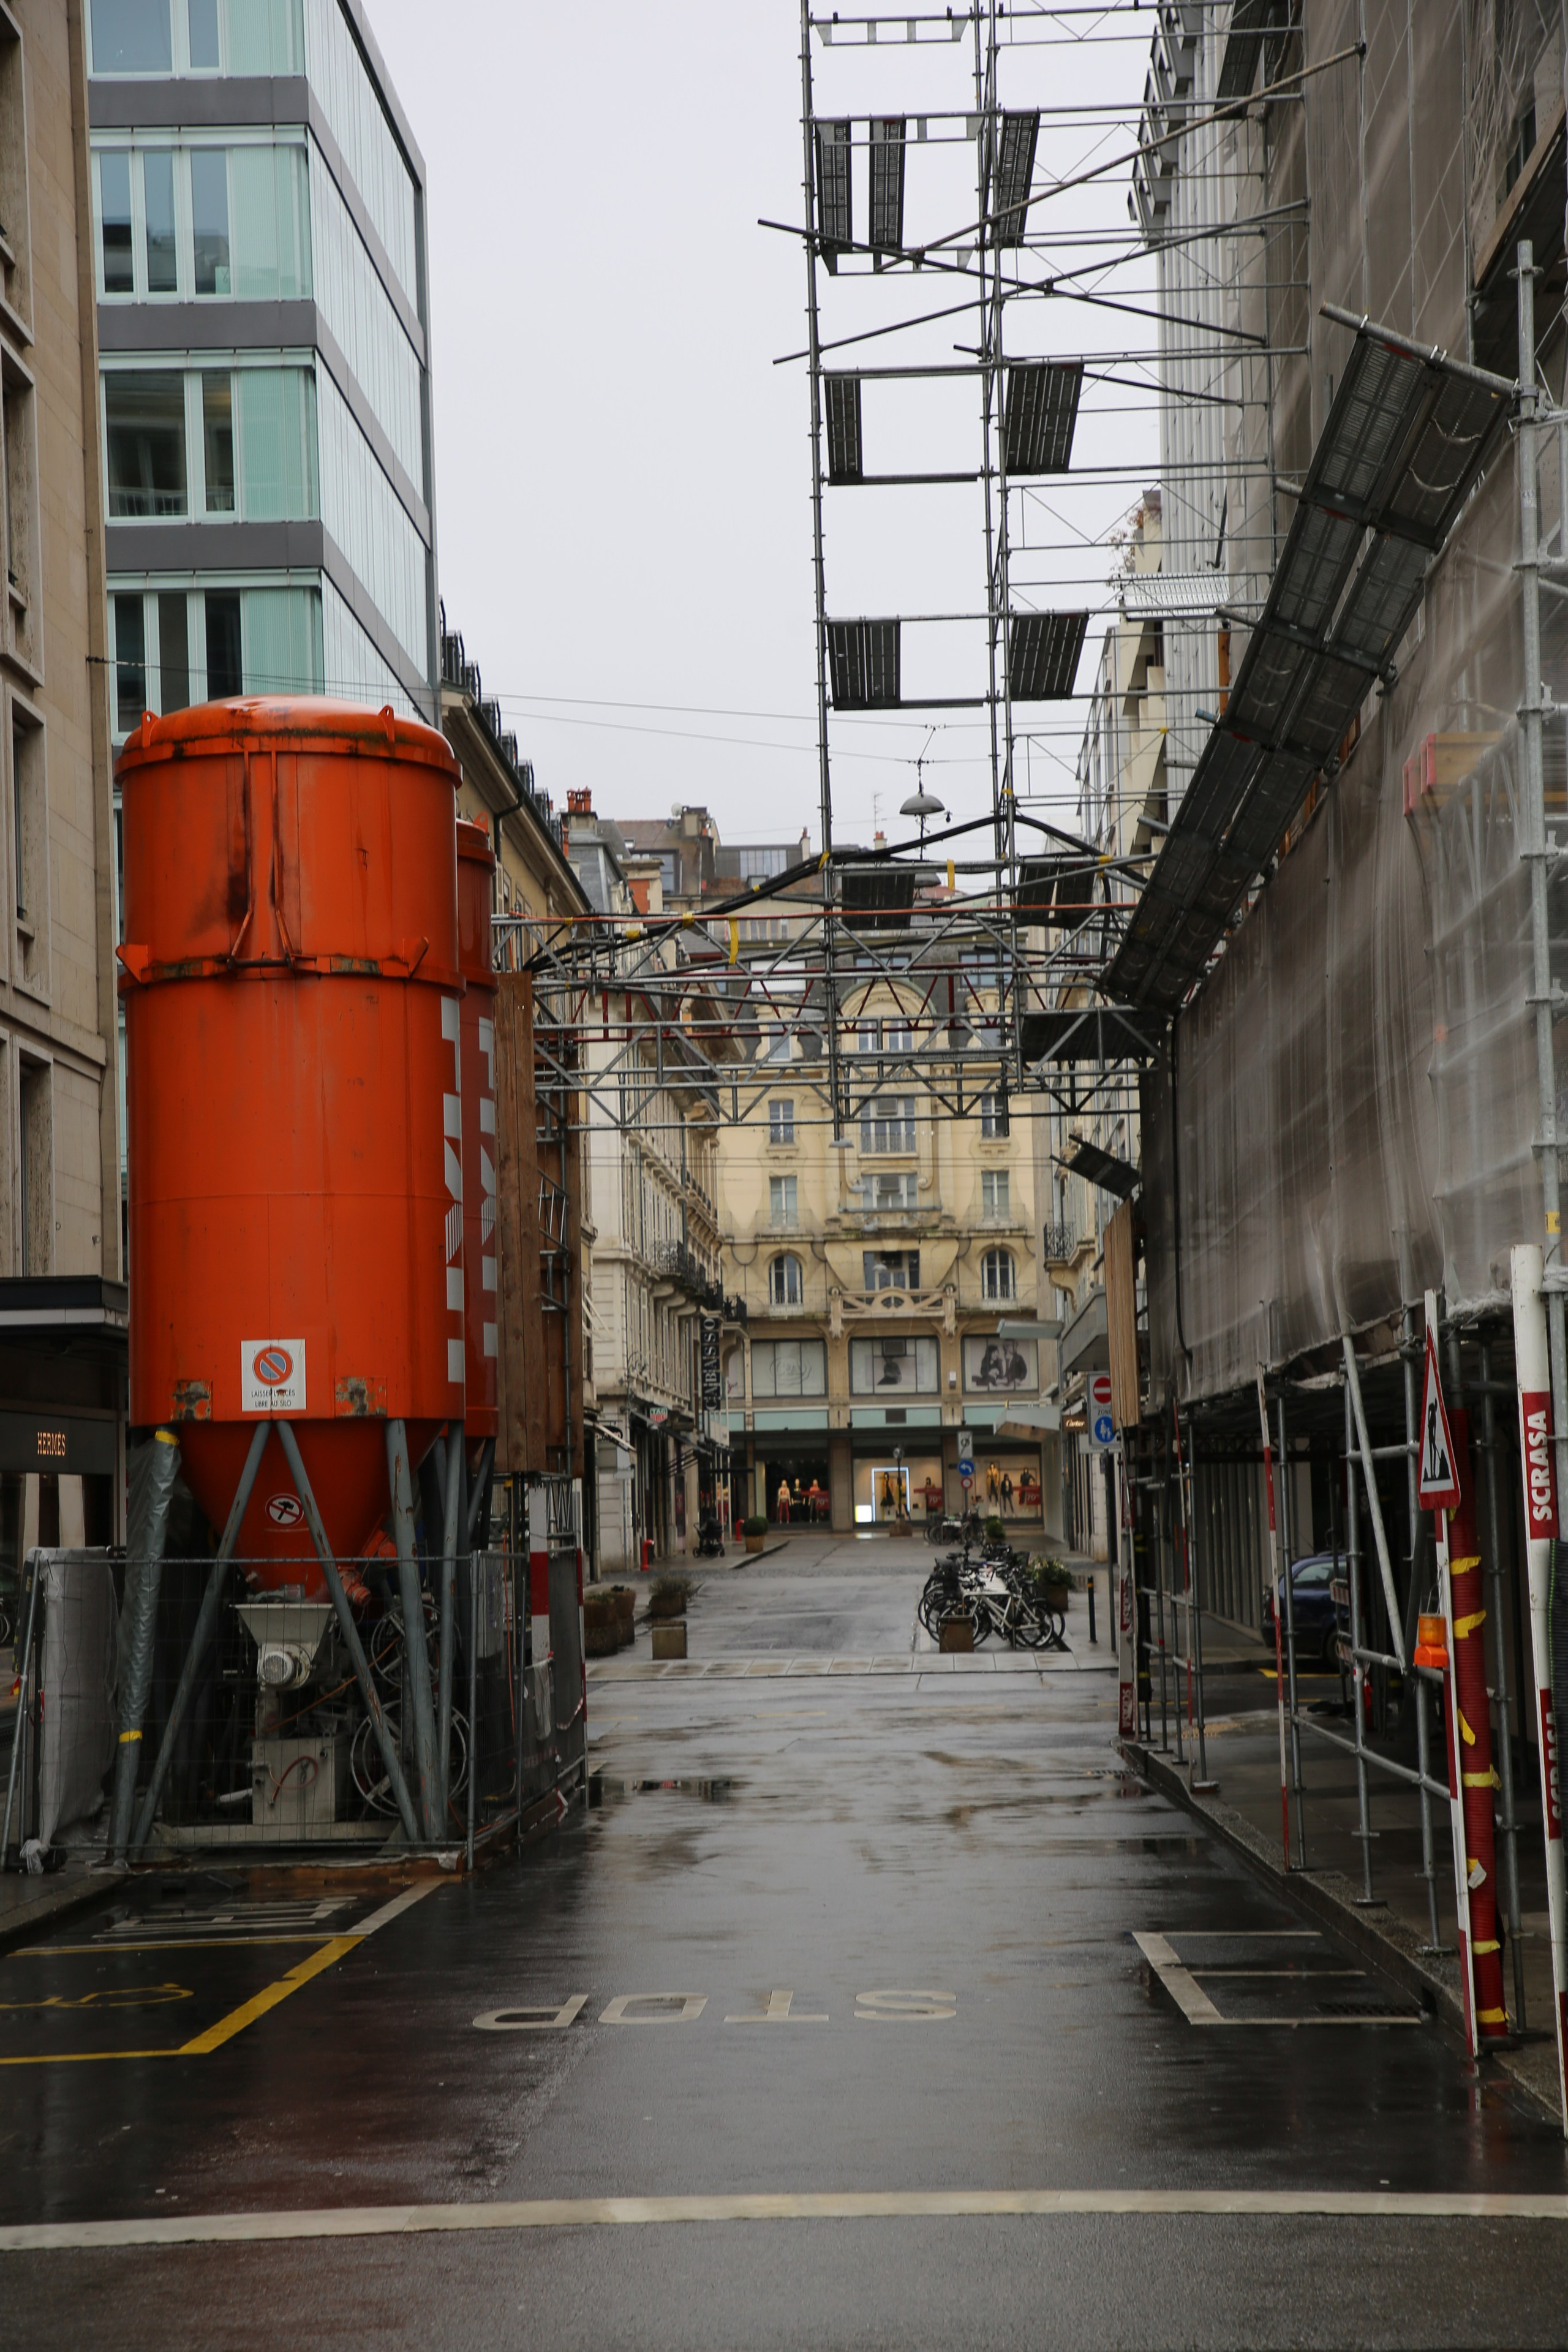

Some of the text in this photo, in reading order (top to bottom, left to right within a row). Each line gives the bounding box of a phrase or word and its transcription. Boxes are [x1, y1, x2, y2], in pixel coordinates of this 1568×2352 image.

[703, 1318, 717, 1410] CABASSO
[1527, 1410, 1553, 1521] SCRASA
[472, 1989, 957, 2030] STOP
